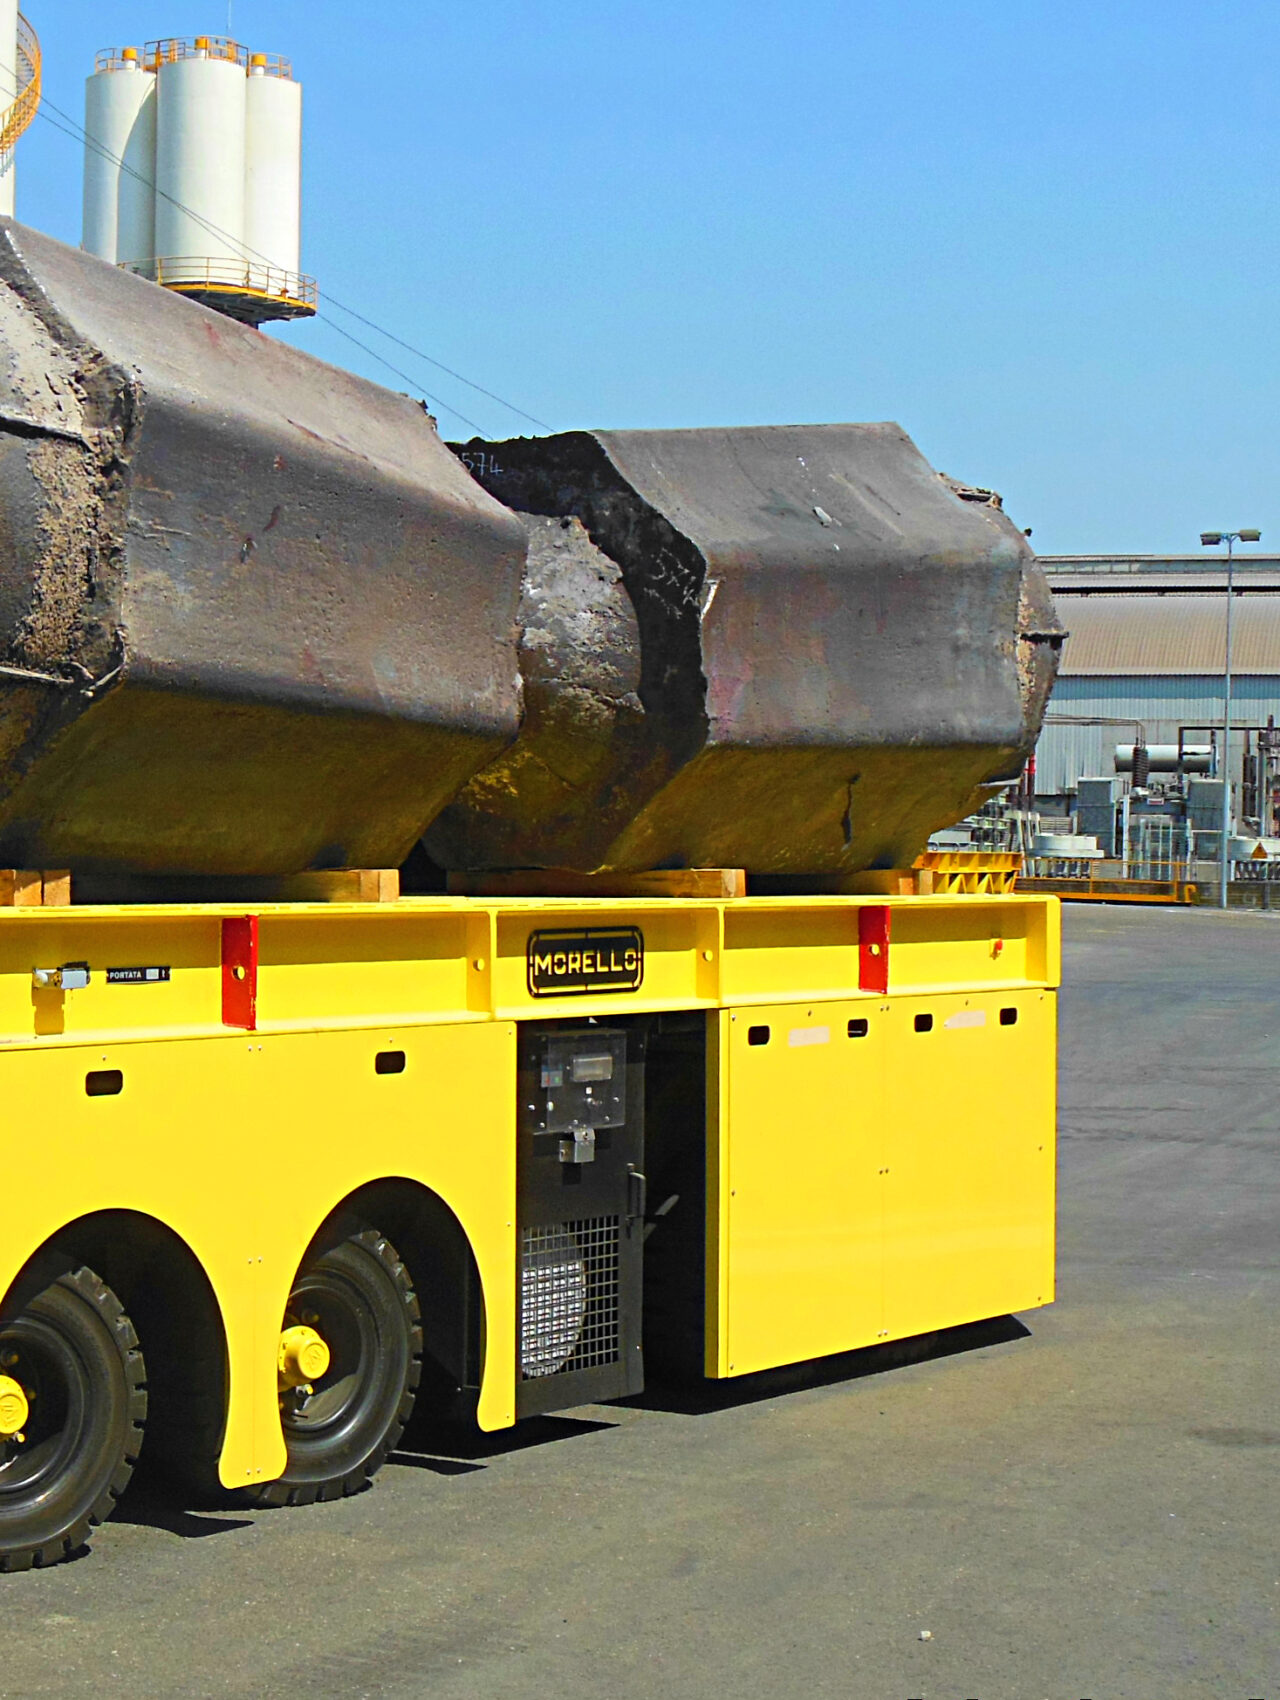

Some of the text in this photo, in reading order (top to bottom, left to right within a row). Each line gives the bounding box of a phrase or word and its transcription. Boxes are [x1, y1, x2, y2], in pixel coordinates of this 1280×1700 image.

[461, 452, 504, 476] 574
[534, 948, 637, 976] MORELLO
[109, 970, 142, 980] PORTATA
